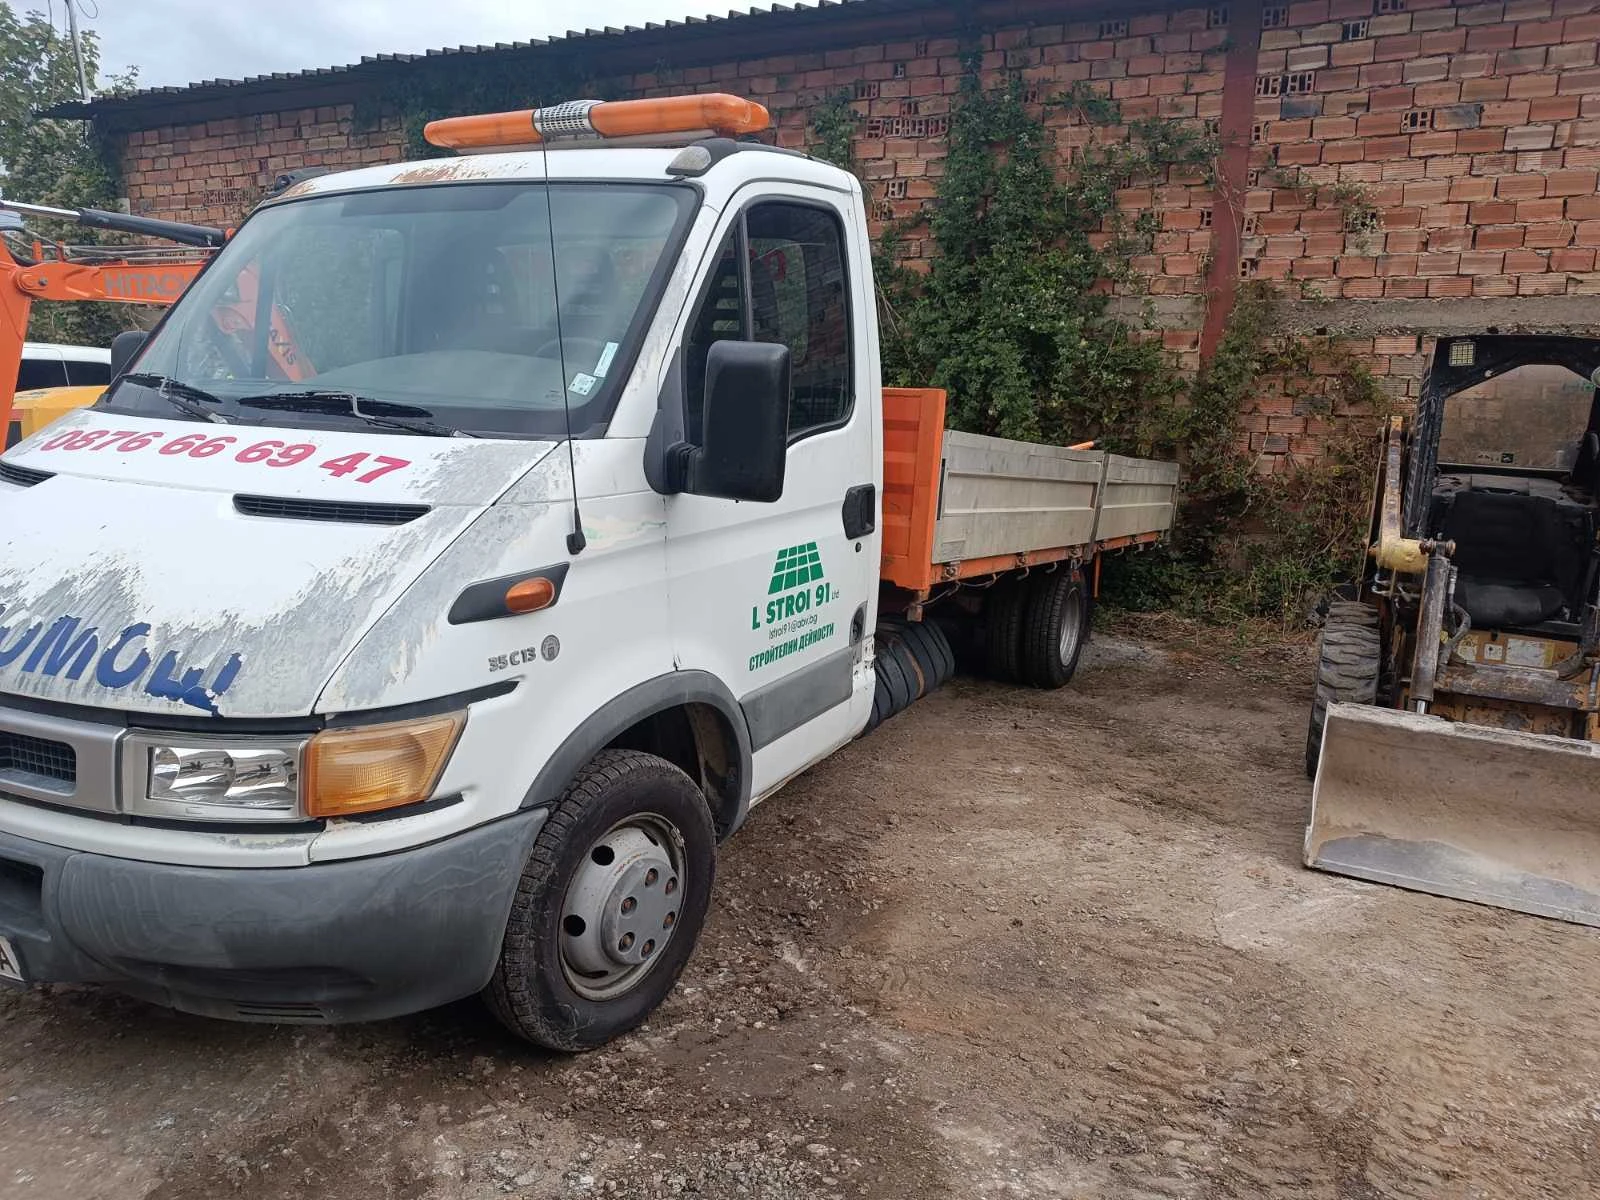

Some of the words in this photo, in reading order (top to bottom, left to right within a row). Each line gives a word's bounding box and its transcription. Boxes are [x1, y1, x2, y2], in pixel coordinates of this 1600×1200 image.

[40, 430, 164, 452] 0876
[158, 434, 237, 458] 66
[234, 440, 317, 467] 69
[319, 452, 412, 484] 47
[752, 606, 760, 630] L
[766, 589, 810, 624] STROI
[815, 582, 830, 607] 91
